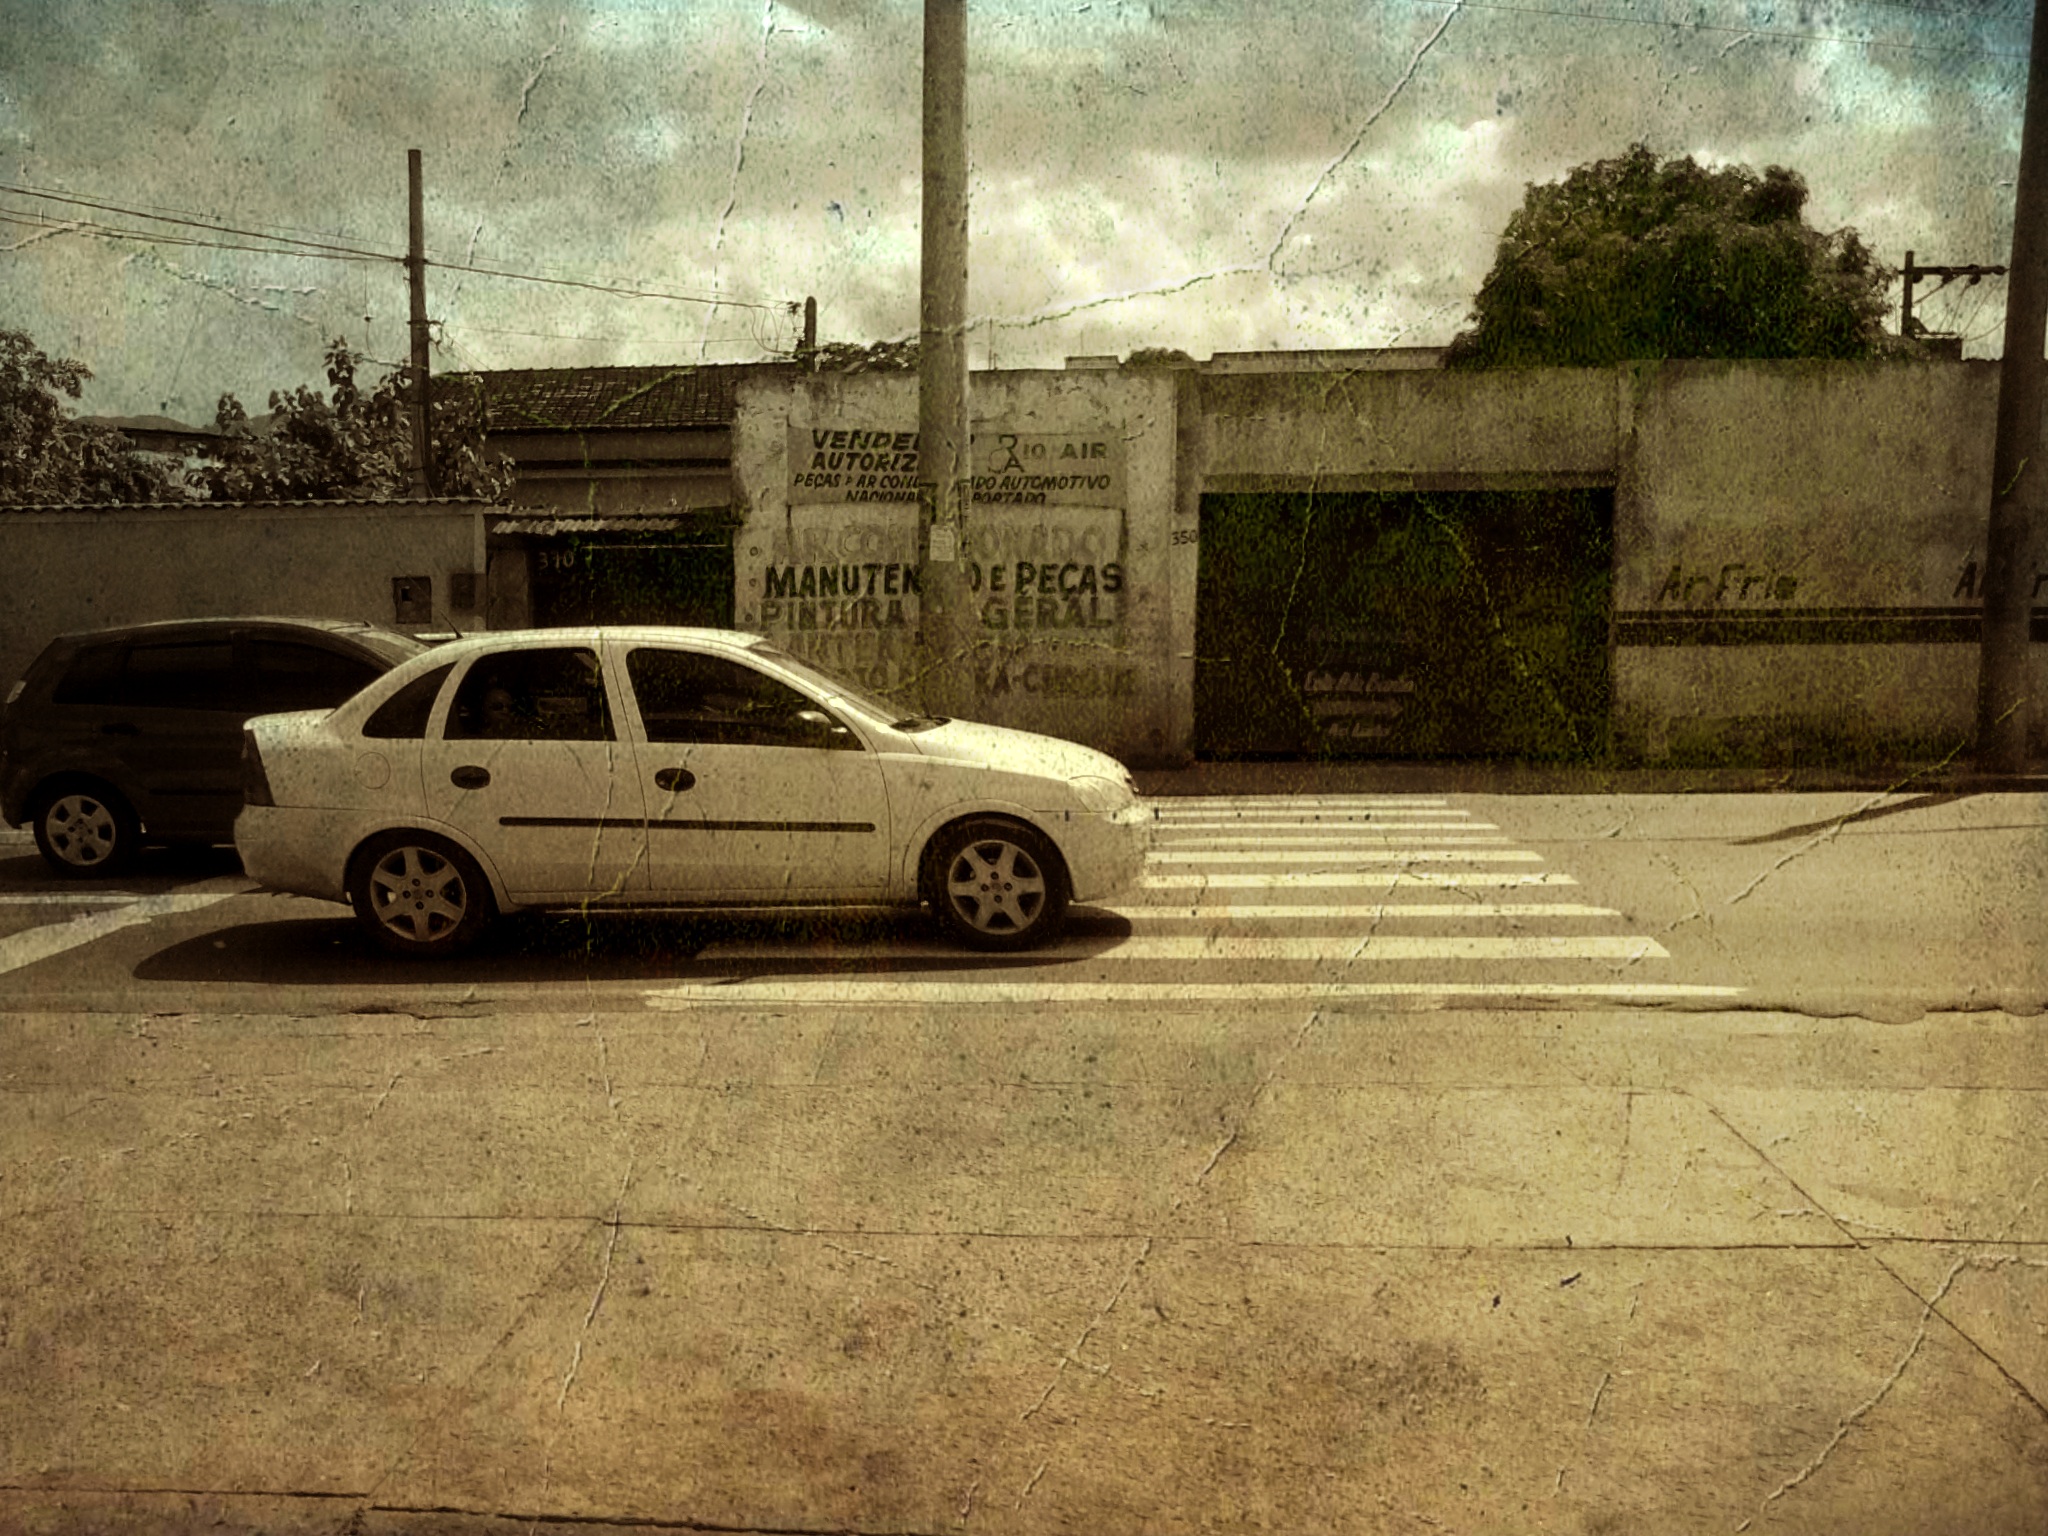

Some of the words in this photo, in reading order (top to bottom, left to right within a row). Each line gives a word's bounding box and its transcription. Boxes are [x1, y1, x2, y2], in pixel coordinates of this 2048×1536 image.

[1059, 443, 1107, 460] AIR
[794, 473, 842, 490] PEÇAS
[856, 475, 877, 489] AR
[999, 475, 1111, 491] AUTOMOTIVO
[1015, 561, 1123, 602] PEÇAS
[1952, 561, 1986, 599] A
[760, 598, 906, 632] PINTURA
[982, 596, 1113, 631] GERAL
